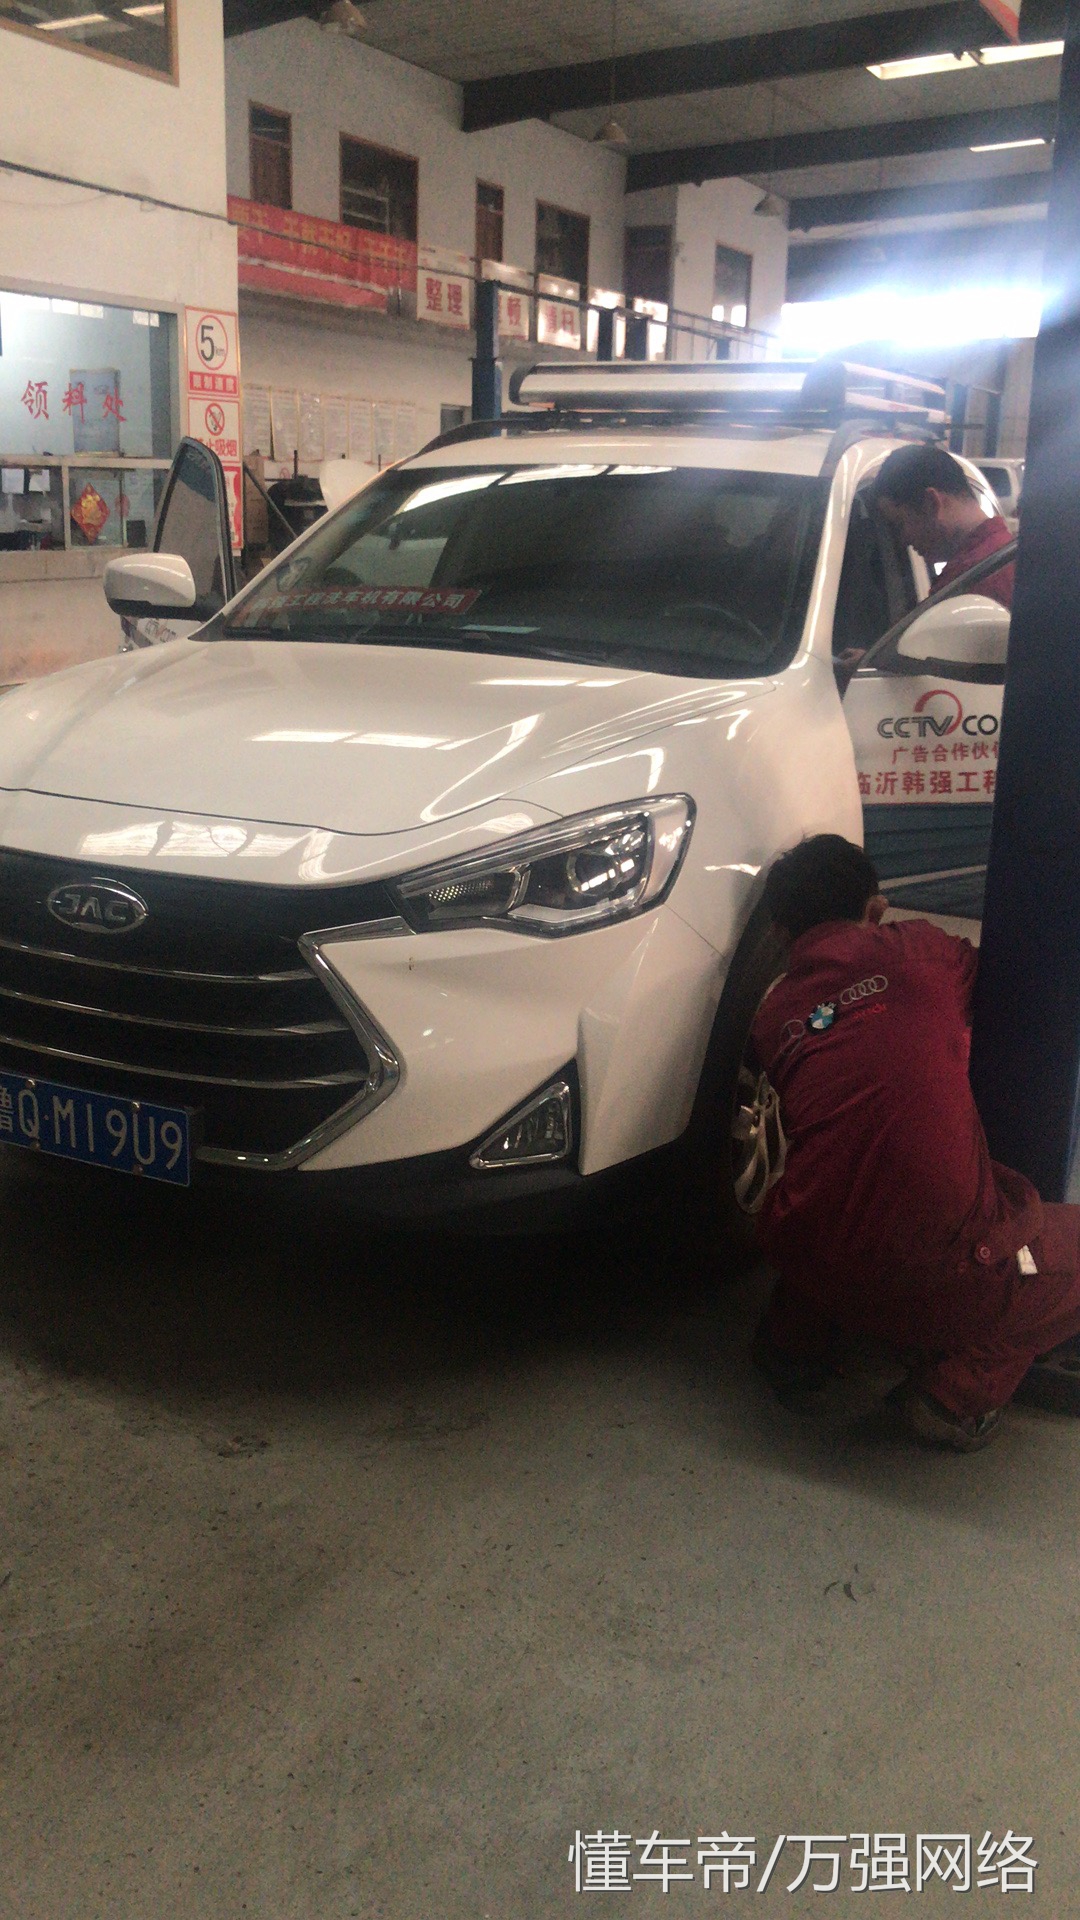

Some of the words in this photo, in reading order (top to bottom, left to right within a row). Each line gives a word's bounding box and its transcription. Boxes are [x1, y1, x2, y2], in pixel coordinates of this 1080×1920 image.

[425, 277, 463, 316] 整理
[201, 324, 215, 362] 5
[21, 380, 127, 425] 领料处
[877, 714, 954, 739] CCTV
[60, 893, 129, 922] JAC
